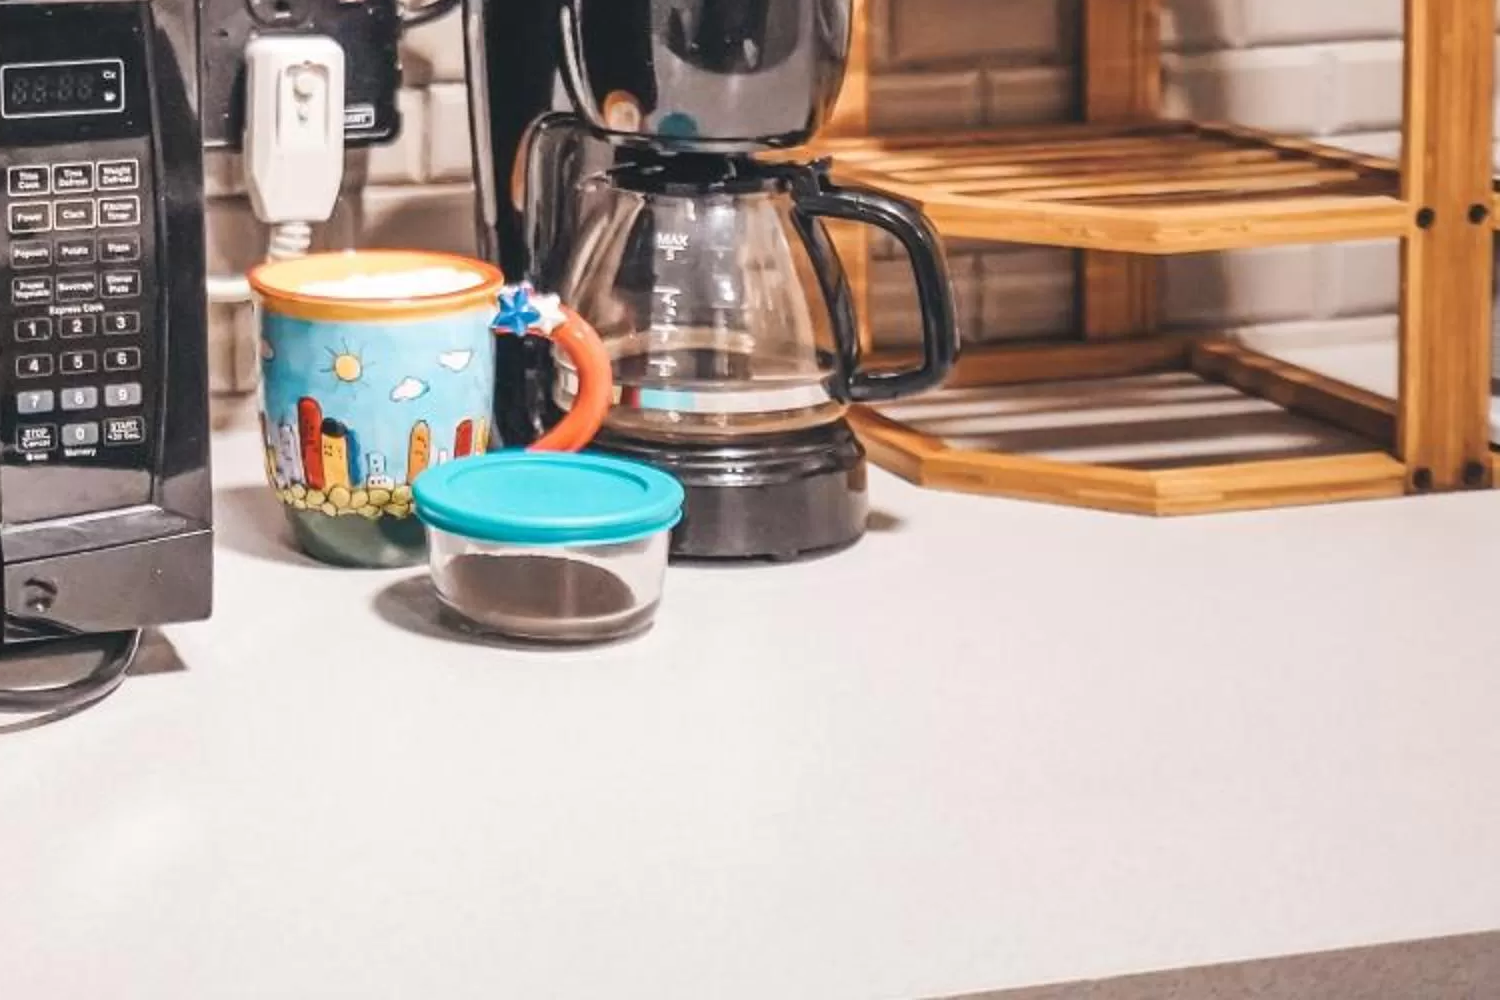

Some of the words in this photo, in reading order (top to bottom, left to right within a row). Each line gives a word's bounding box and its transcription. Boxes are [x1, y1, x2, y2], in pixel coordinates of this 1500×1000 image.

[657, 232, 689, 246] MAX
[28, 322, 37, 337] 1
[72, 319, 83, 333] 2
[116, 316, 126, 329] 3
[73, 356, 83, 369] 5
[117, 352, 127, 365] 6
[29, 359, 40, 373] 4
[30, 395, 40, 409] 7
[117, 388, 128, 402] 9
[75, 427, 85, 441] 0
